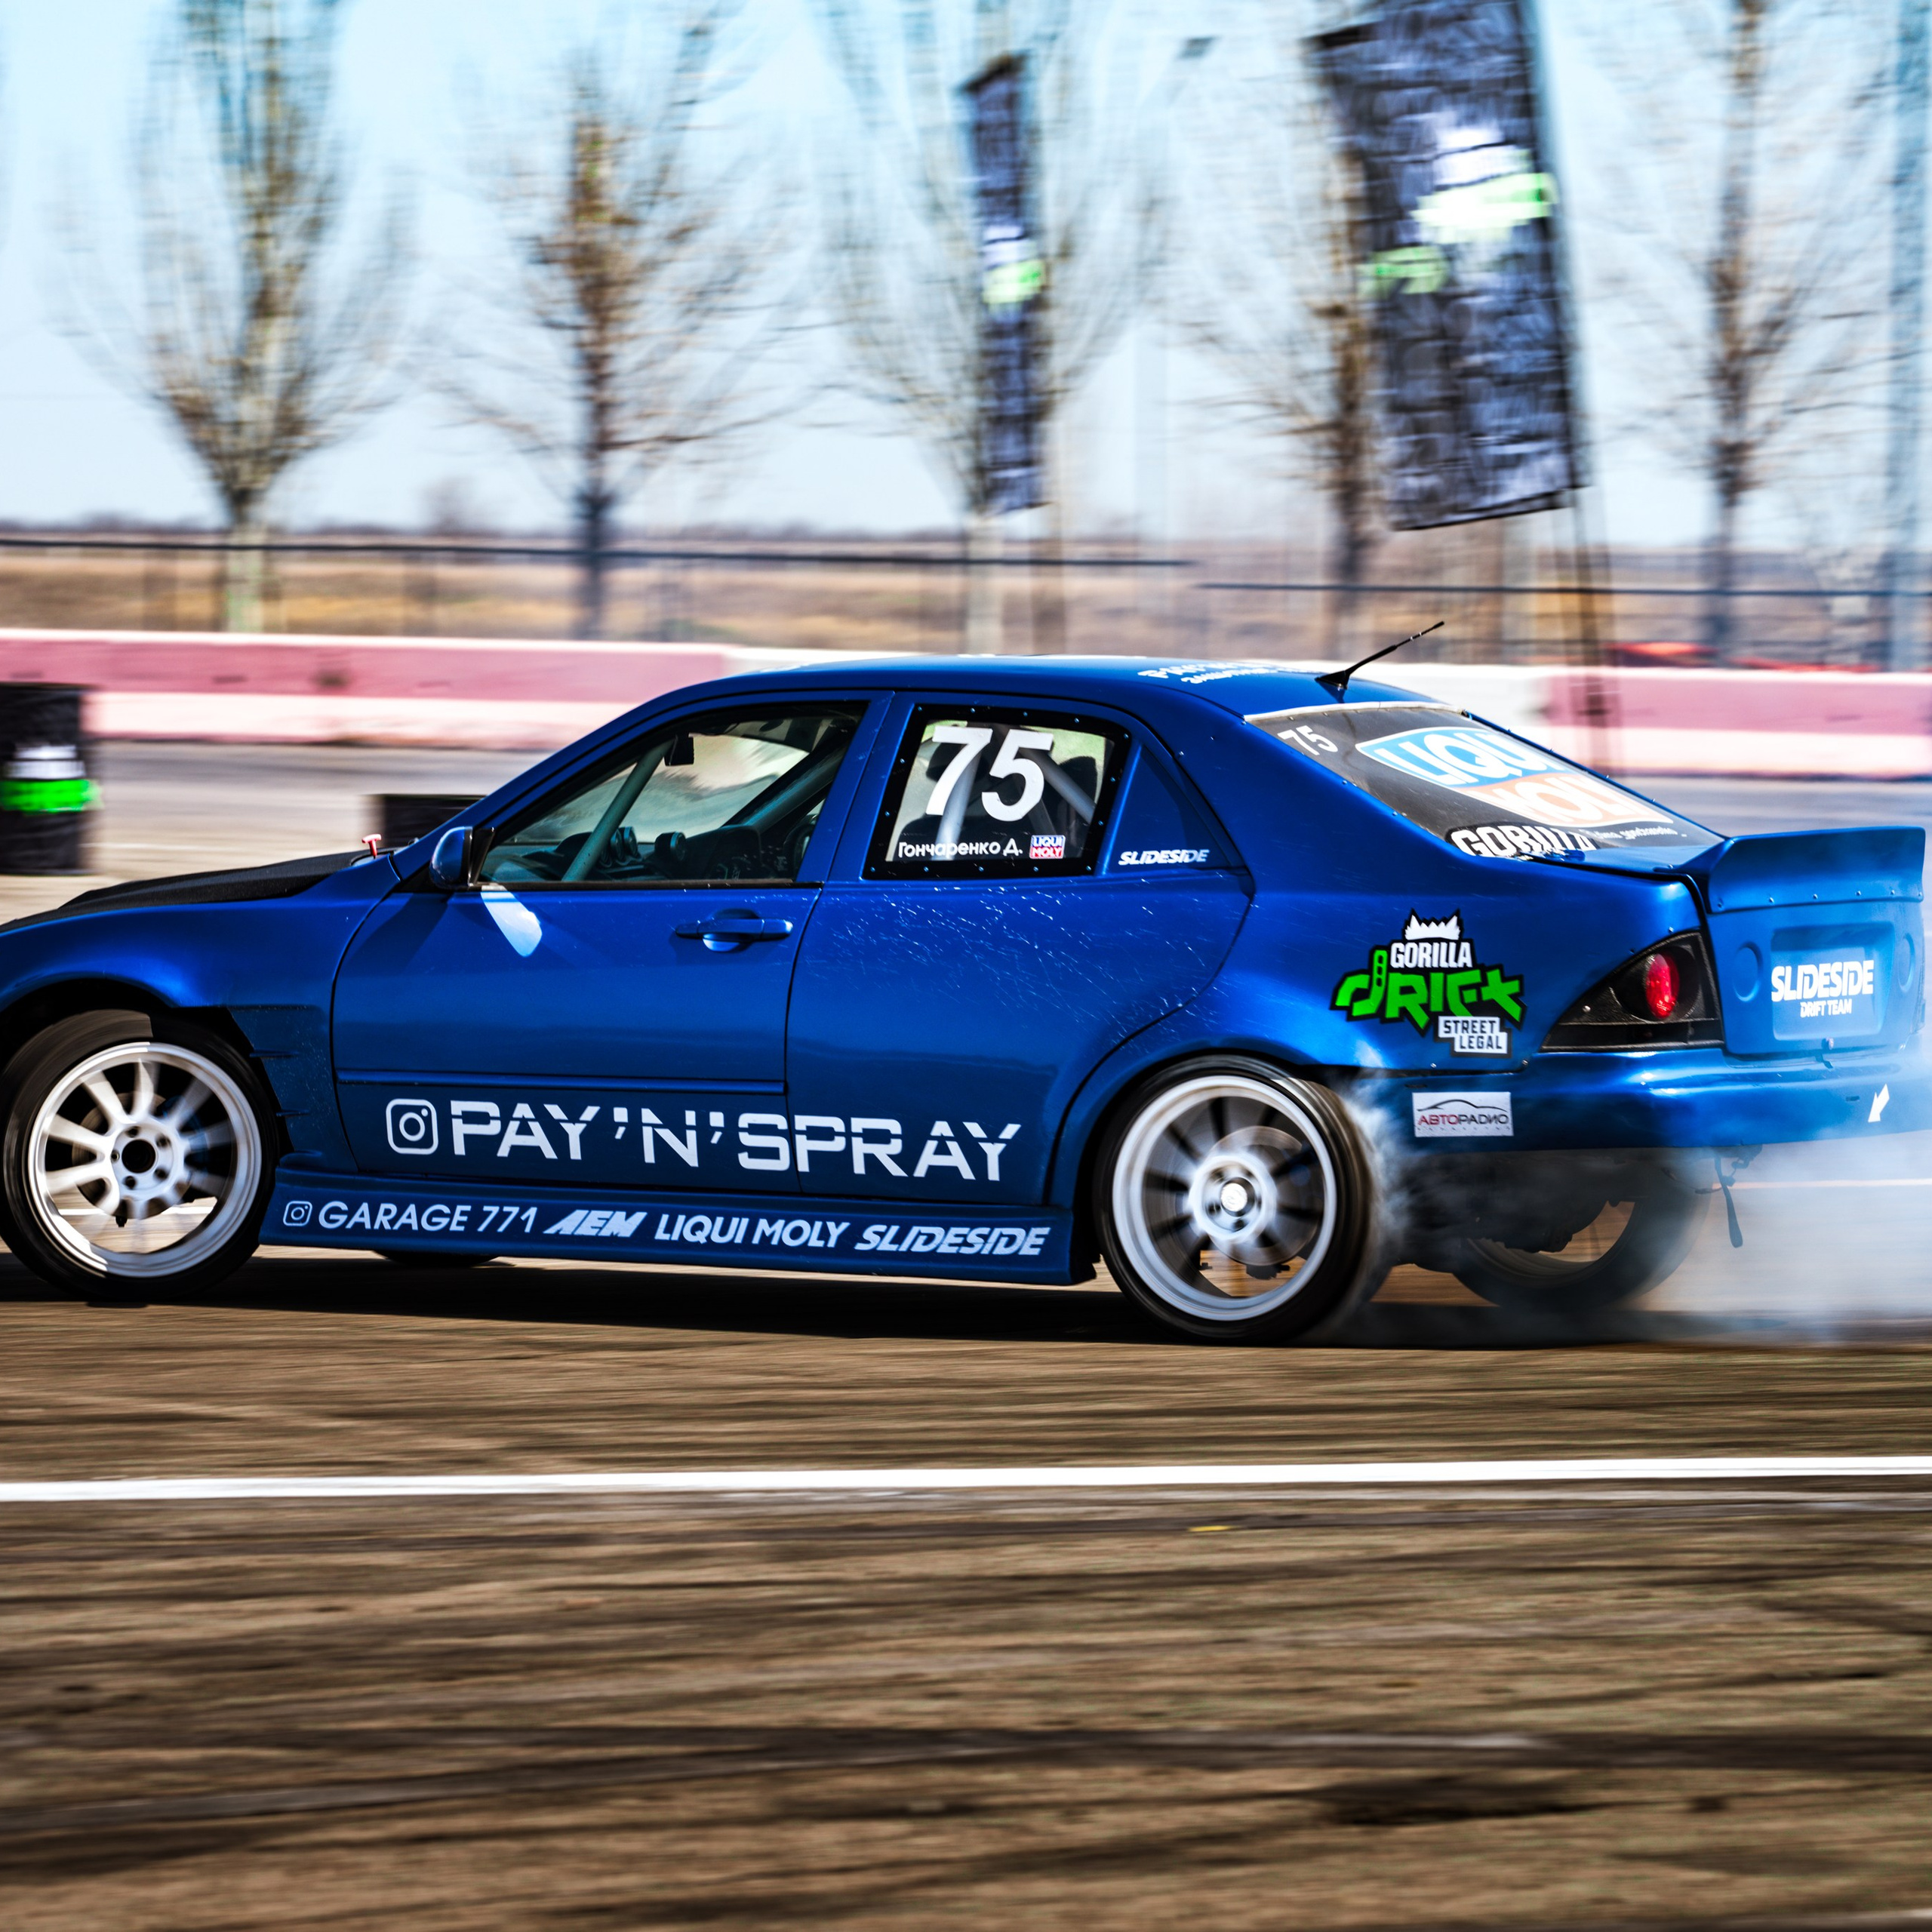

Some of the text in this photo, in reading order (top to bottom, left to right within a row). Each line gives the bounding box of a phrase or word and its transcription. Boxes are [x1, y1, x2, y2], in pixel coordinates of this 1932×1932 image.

[1277, 725, 1338, 755] 75
[925, 726, 1054, 822] 75
[898, 838, 1023, 859] Гончаренко Д.
[1033, 836, 1063, 847] LIQUI
[1031, 847, 1062, 857] MOLY
[1118, 849, 1210, 866] SLIDESIDE
[1390, 942, 1473, 968] GORILLA
[1771, 959, 1874, 1002] SLIDESIDE
[1800, 998, 1853, 1018] DRIFT TEAM
[1443, 1020, 1497, 1034] STREET
[1459, 1035, 1503, 1050] LEGAL
[1418, 1114, 1509, 1125] АВТОРАДИО
[318, 1200, 1051, 1256] GARAGE 771 AEM LIQUI MOLY SLIDESIDE
